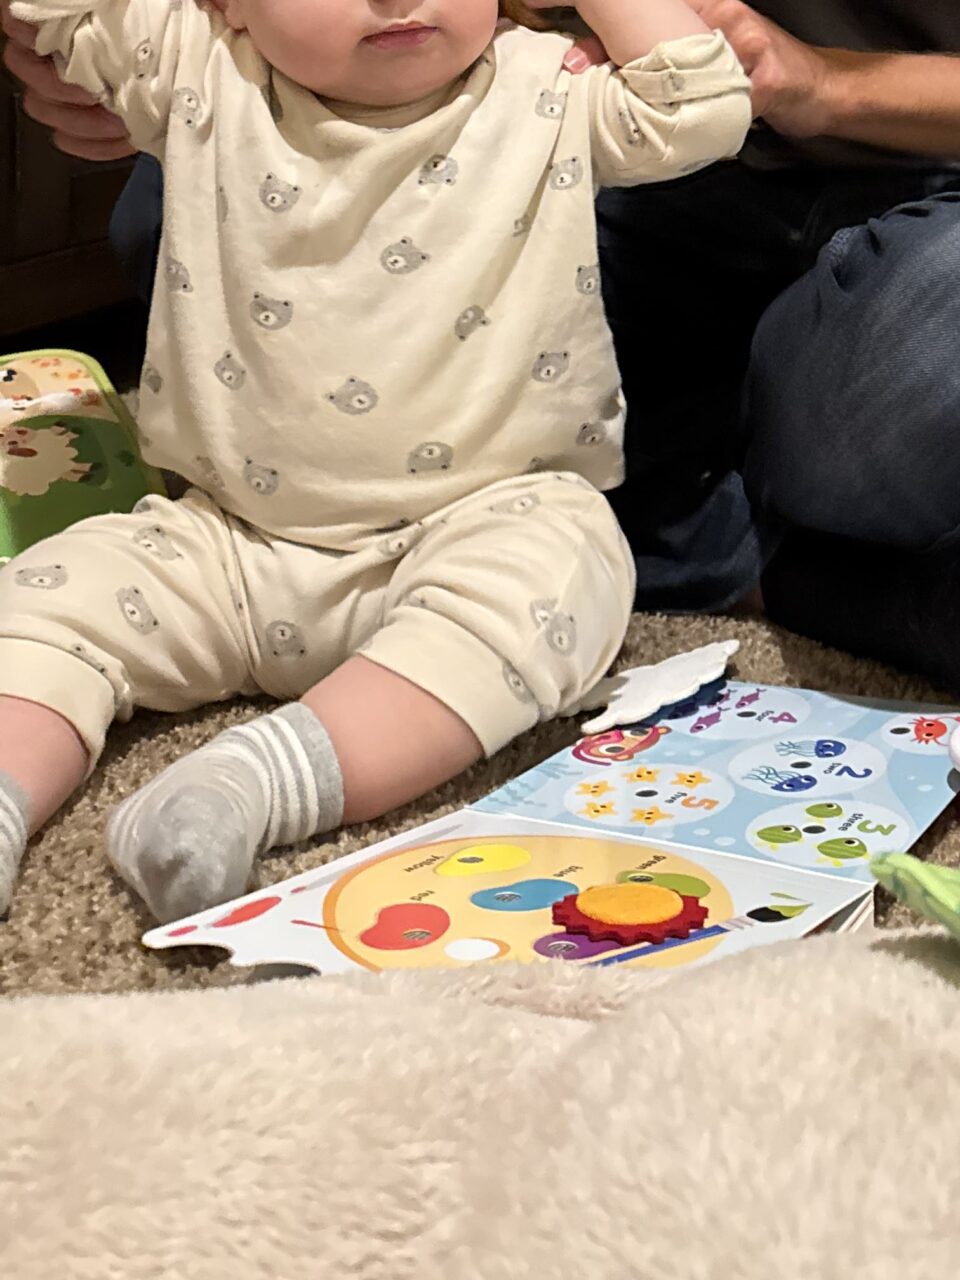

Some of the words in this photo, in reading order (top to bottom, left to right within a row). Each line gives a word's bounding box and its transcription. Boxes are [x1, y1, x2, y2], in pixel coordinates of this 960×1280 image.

[823, 762, 842, 775] two
[835, 765, 873, 779] 2
[681, 796, 719, 811] 5
[838, 813, 864, 832] three
[857, 819, 897, 836] 3
